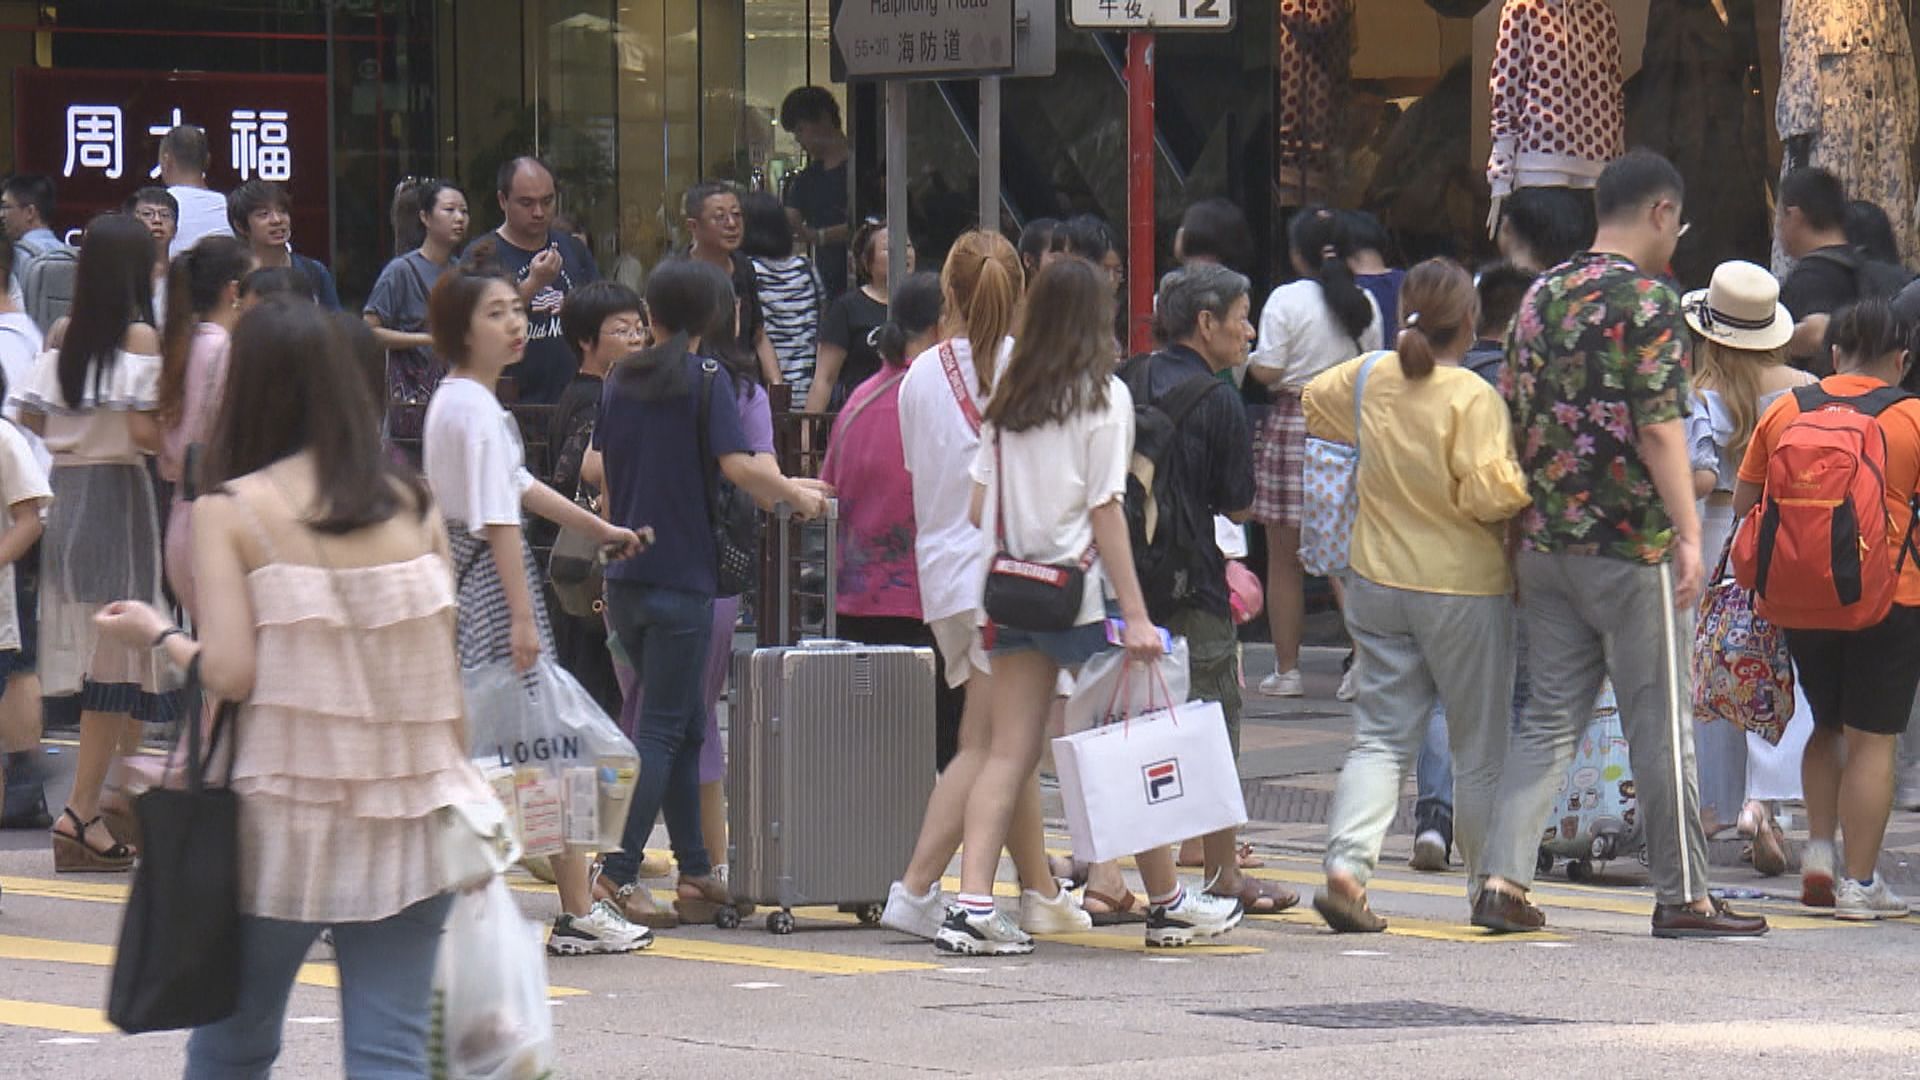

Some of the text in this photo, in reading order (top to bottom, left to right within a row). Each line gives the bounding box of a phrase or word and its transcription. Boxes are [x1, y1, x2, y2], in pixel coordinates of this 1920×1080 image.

[898, 29, 962, 63] 海防道
[497, 736, 578, 767] LOGIN
